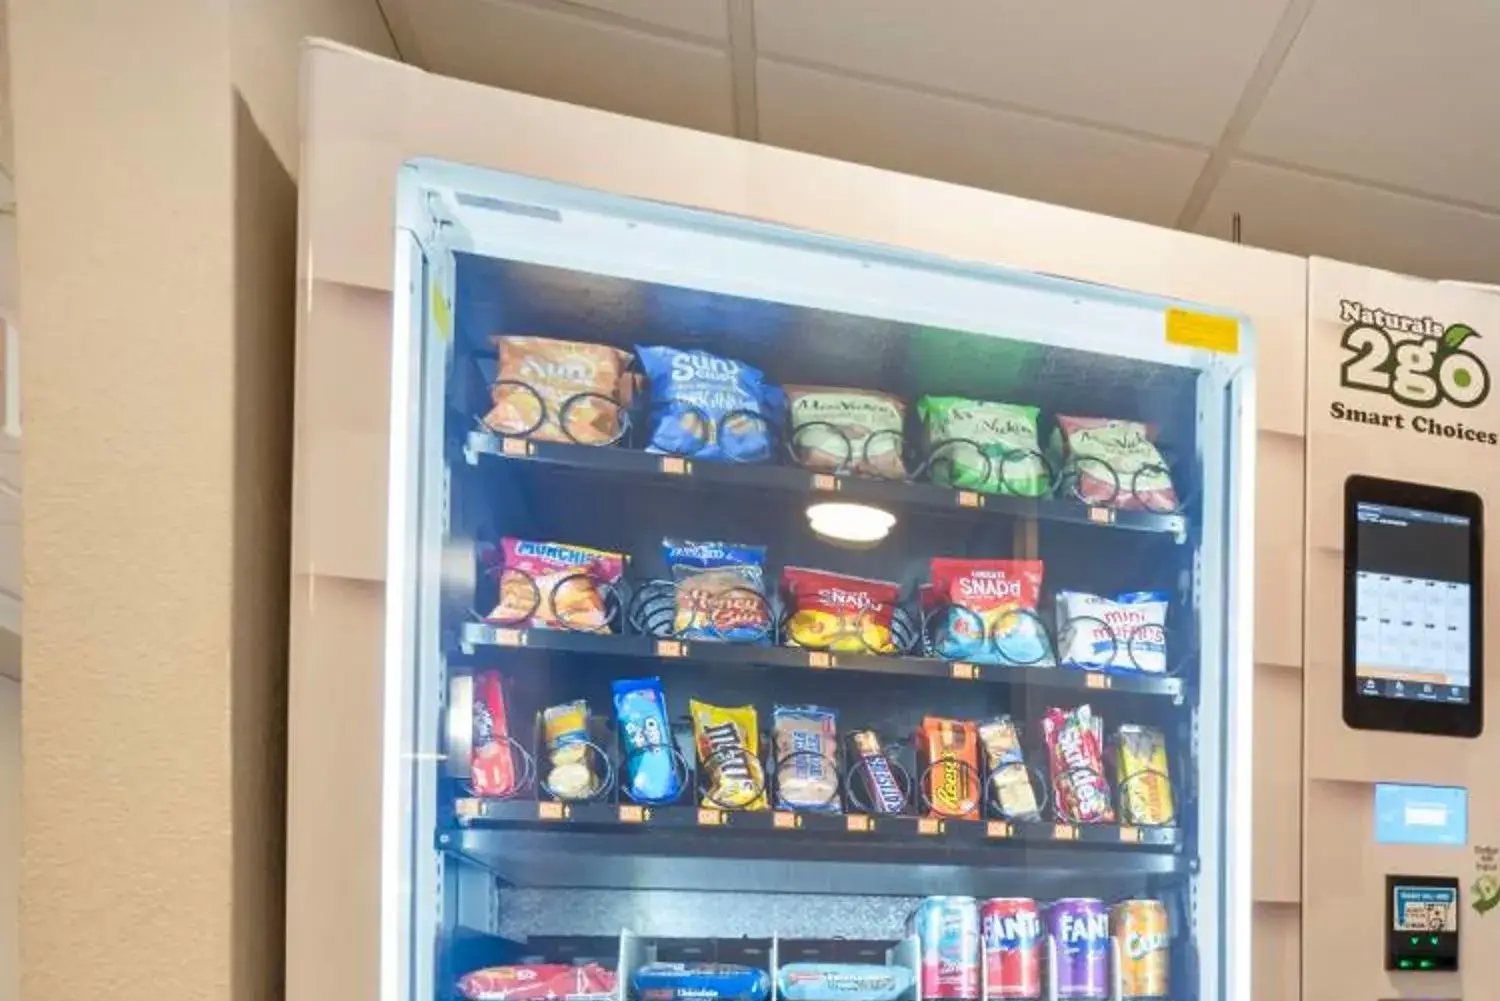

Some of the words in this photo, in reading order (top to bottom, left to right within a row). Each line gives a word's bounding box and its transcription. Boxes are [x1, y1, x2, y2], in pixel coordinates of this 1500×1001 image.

[1339, 299, 1444, 337] Naturals
[1340, 323, 1490, 408] 2go
[1330, 401, 1405, 430] Smart
[1411, 415, 1498, 445] Choices
[1104, 609, 1147, 623] mini
